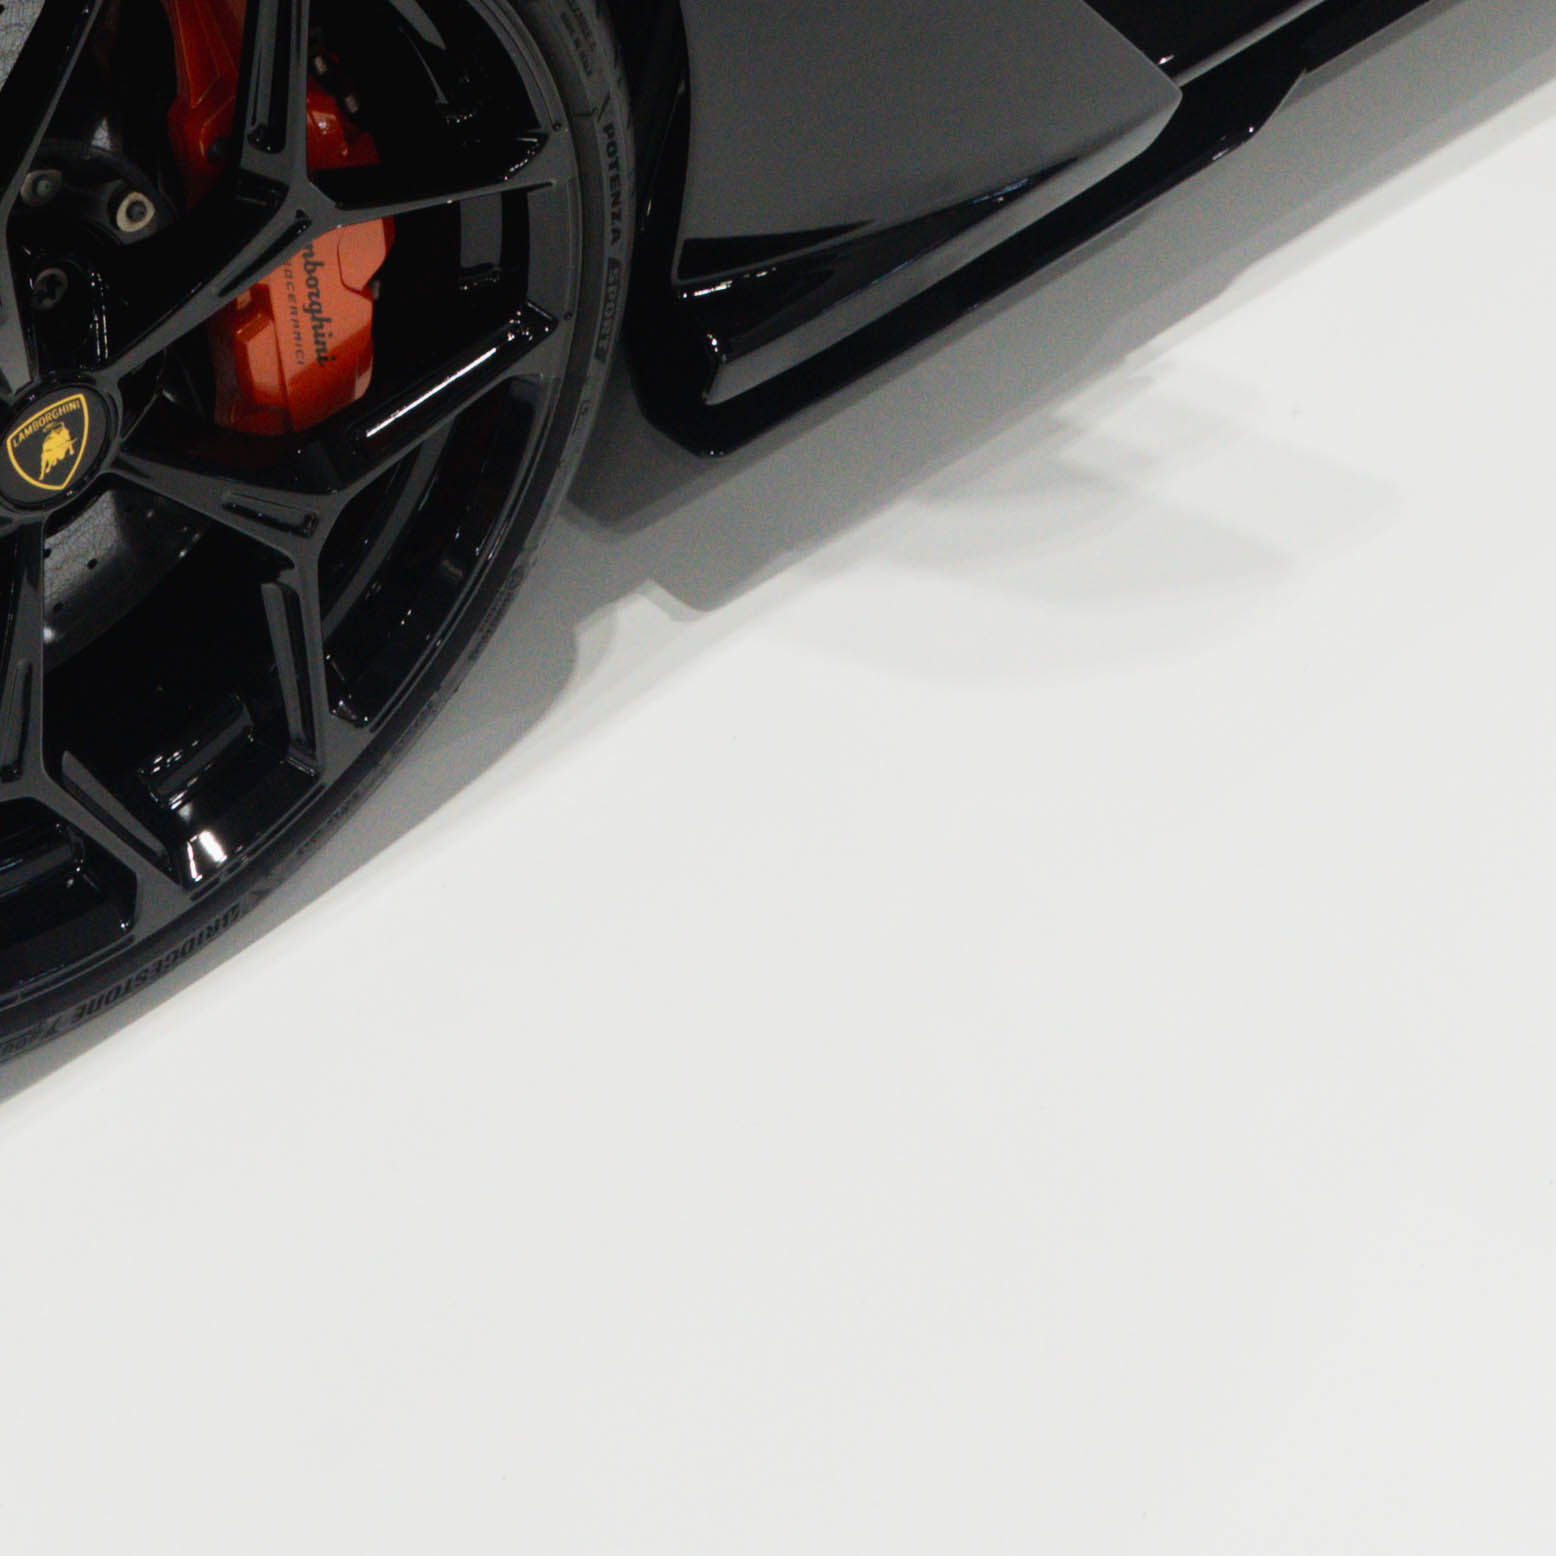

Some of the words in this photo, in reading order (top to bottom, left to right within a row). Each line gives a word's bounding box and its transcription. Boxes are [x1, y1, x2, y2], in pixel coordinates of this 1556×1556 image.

[598, 121, 626, 245] POTENZA
[301, 241, 336, 367] mborghini
[12, 399, 81, 448] LAMBORGHINI
